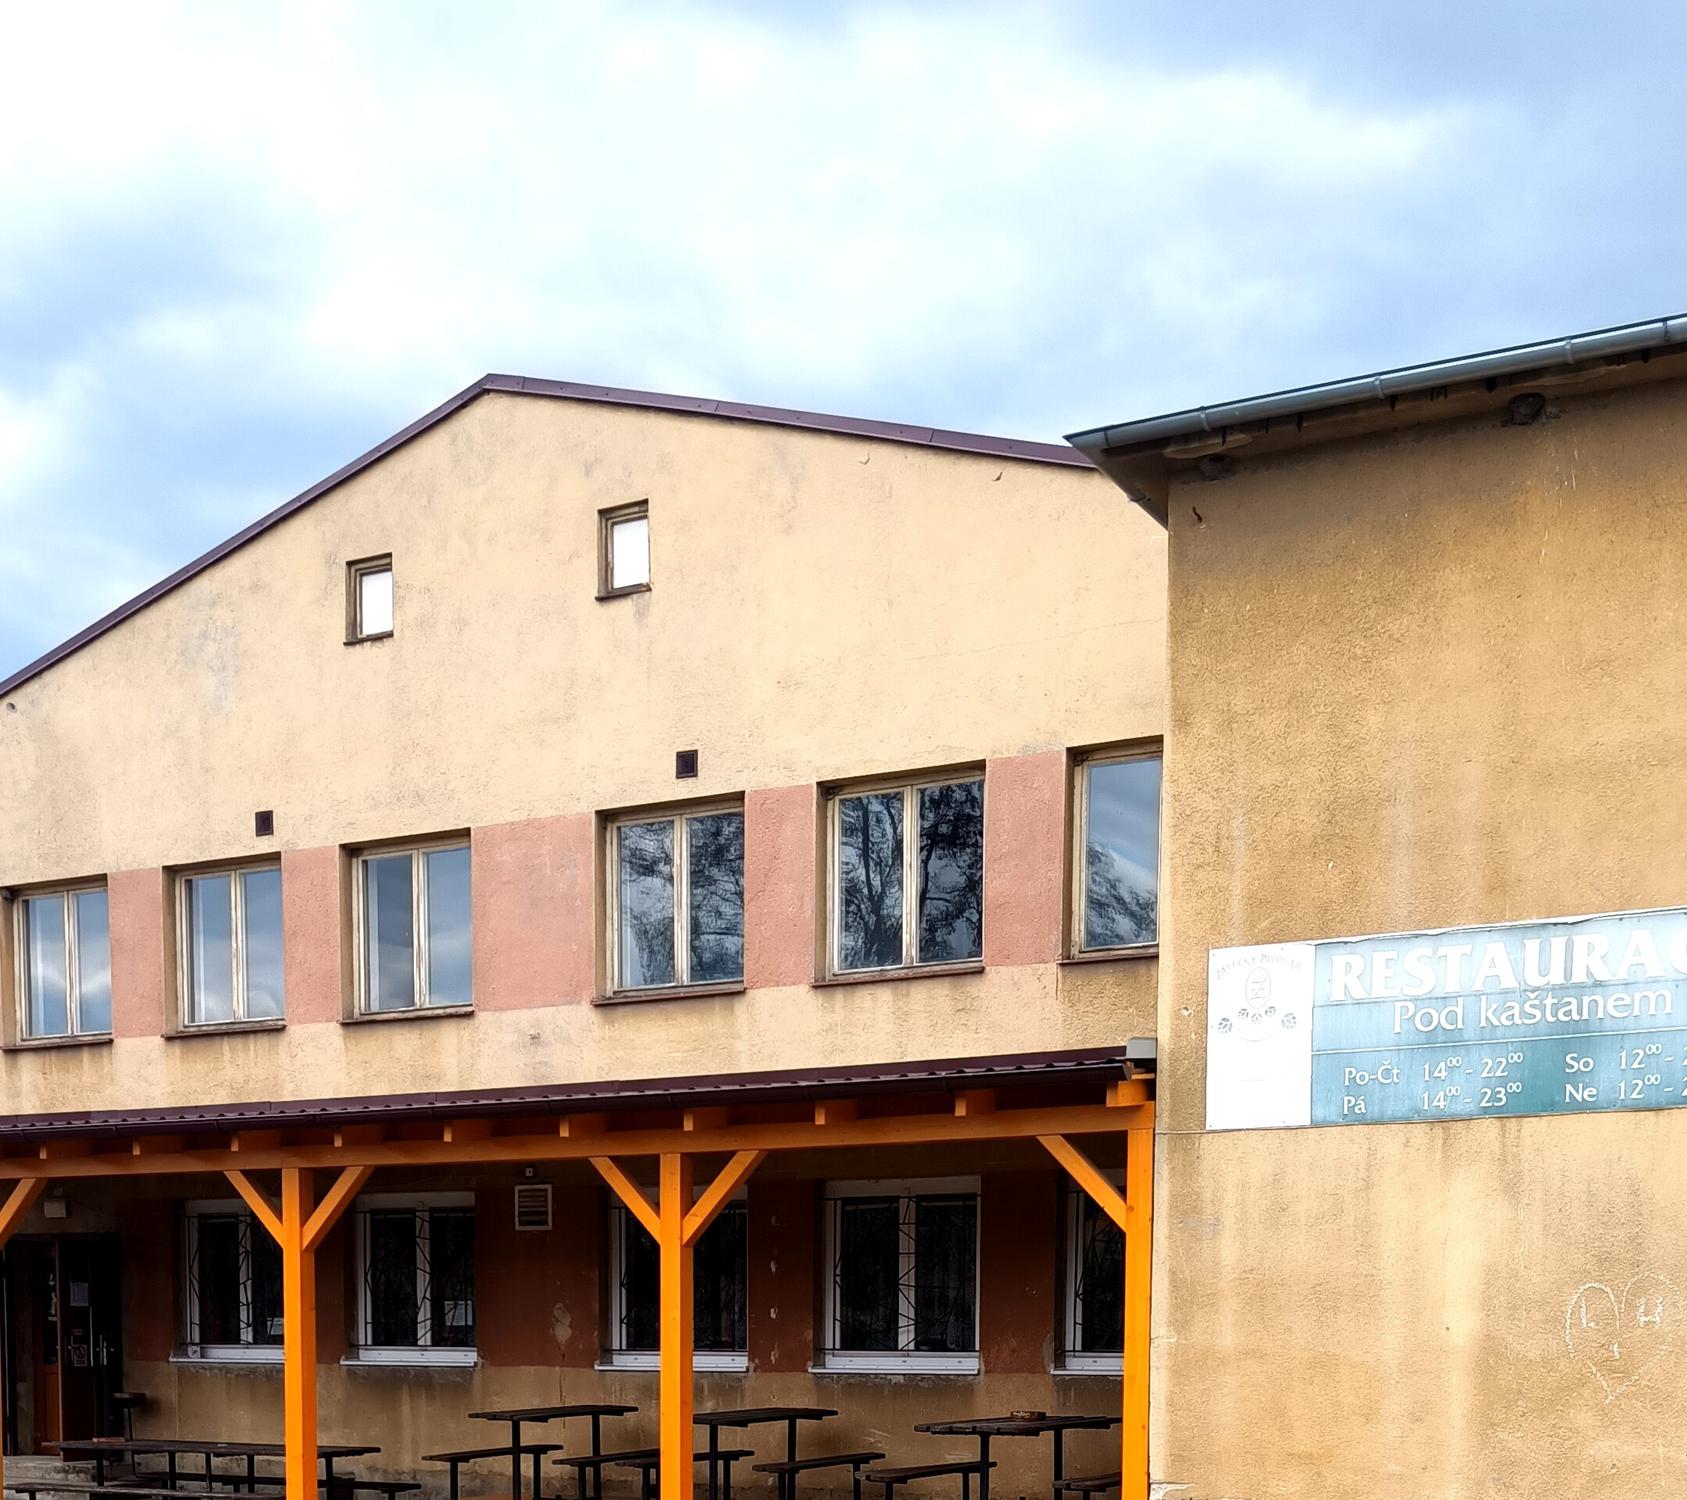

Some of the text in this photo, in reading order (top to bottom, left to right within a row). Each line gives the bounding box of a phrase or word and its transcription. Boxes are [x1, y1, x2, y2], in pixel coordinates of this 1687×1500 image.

[1393, 990, 1672, 1034] Pod kaštanem
[1344, 1059, 1400, 1086] Po-Čt
[1565, 1053, 1594, 1073] So
[1564, 1082, 1598, 1103] Ne
[1343, 1095, 1367, 1114] Pá
